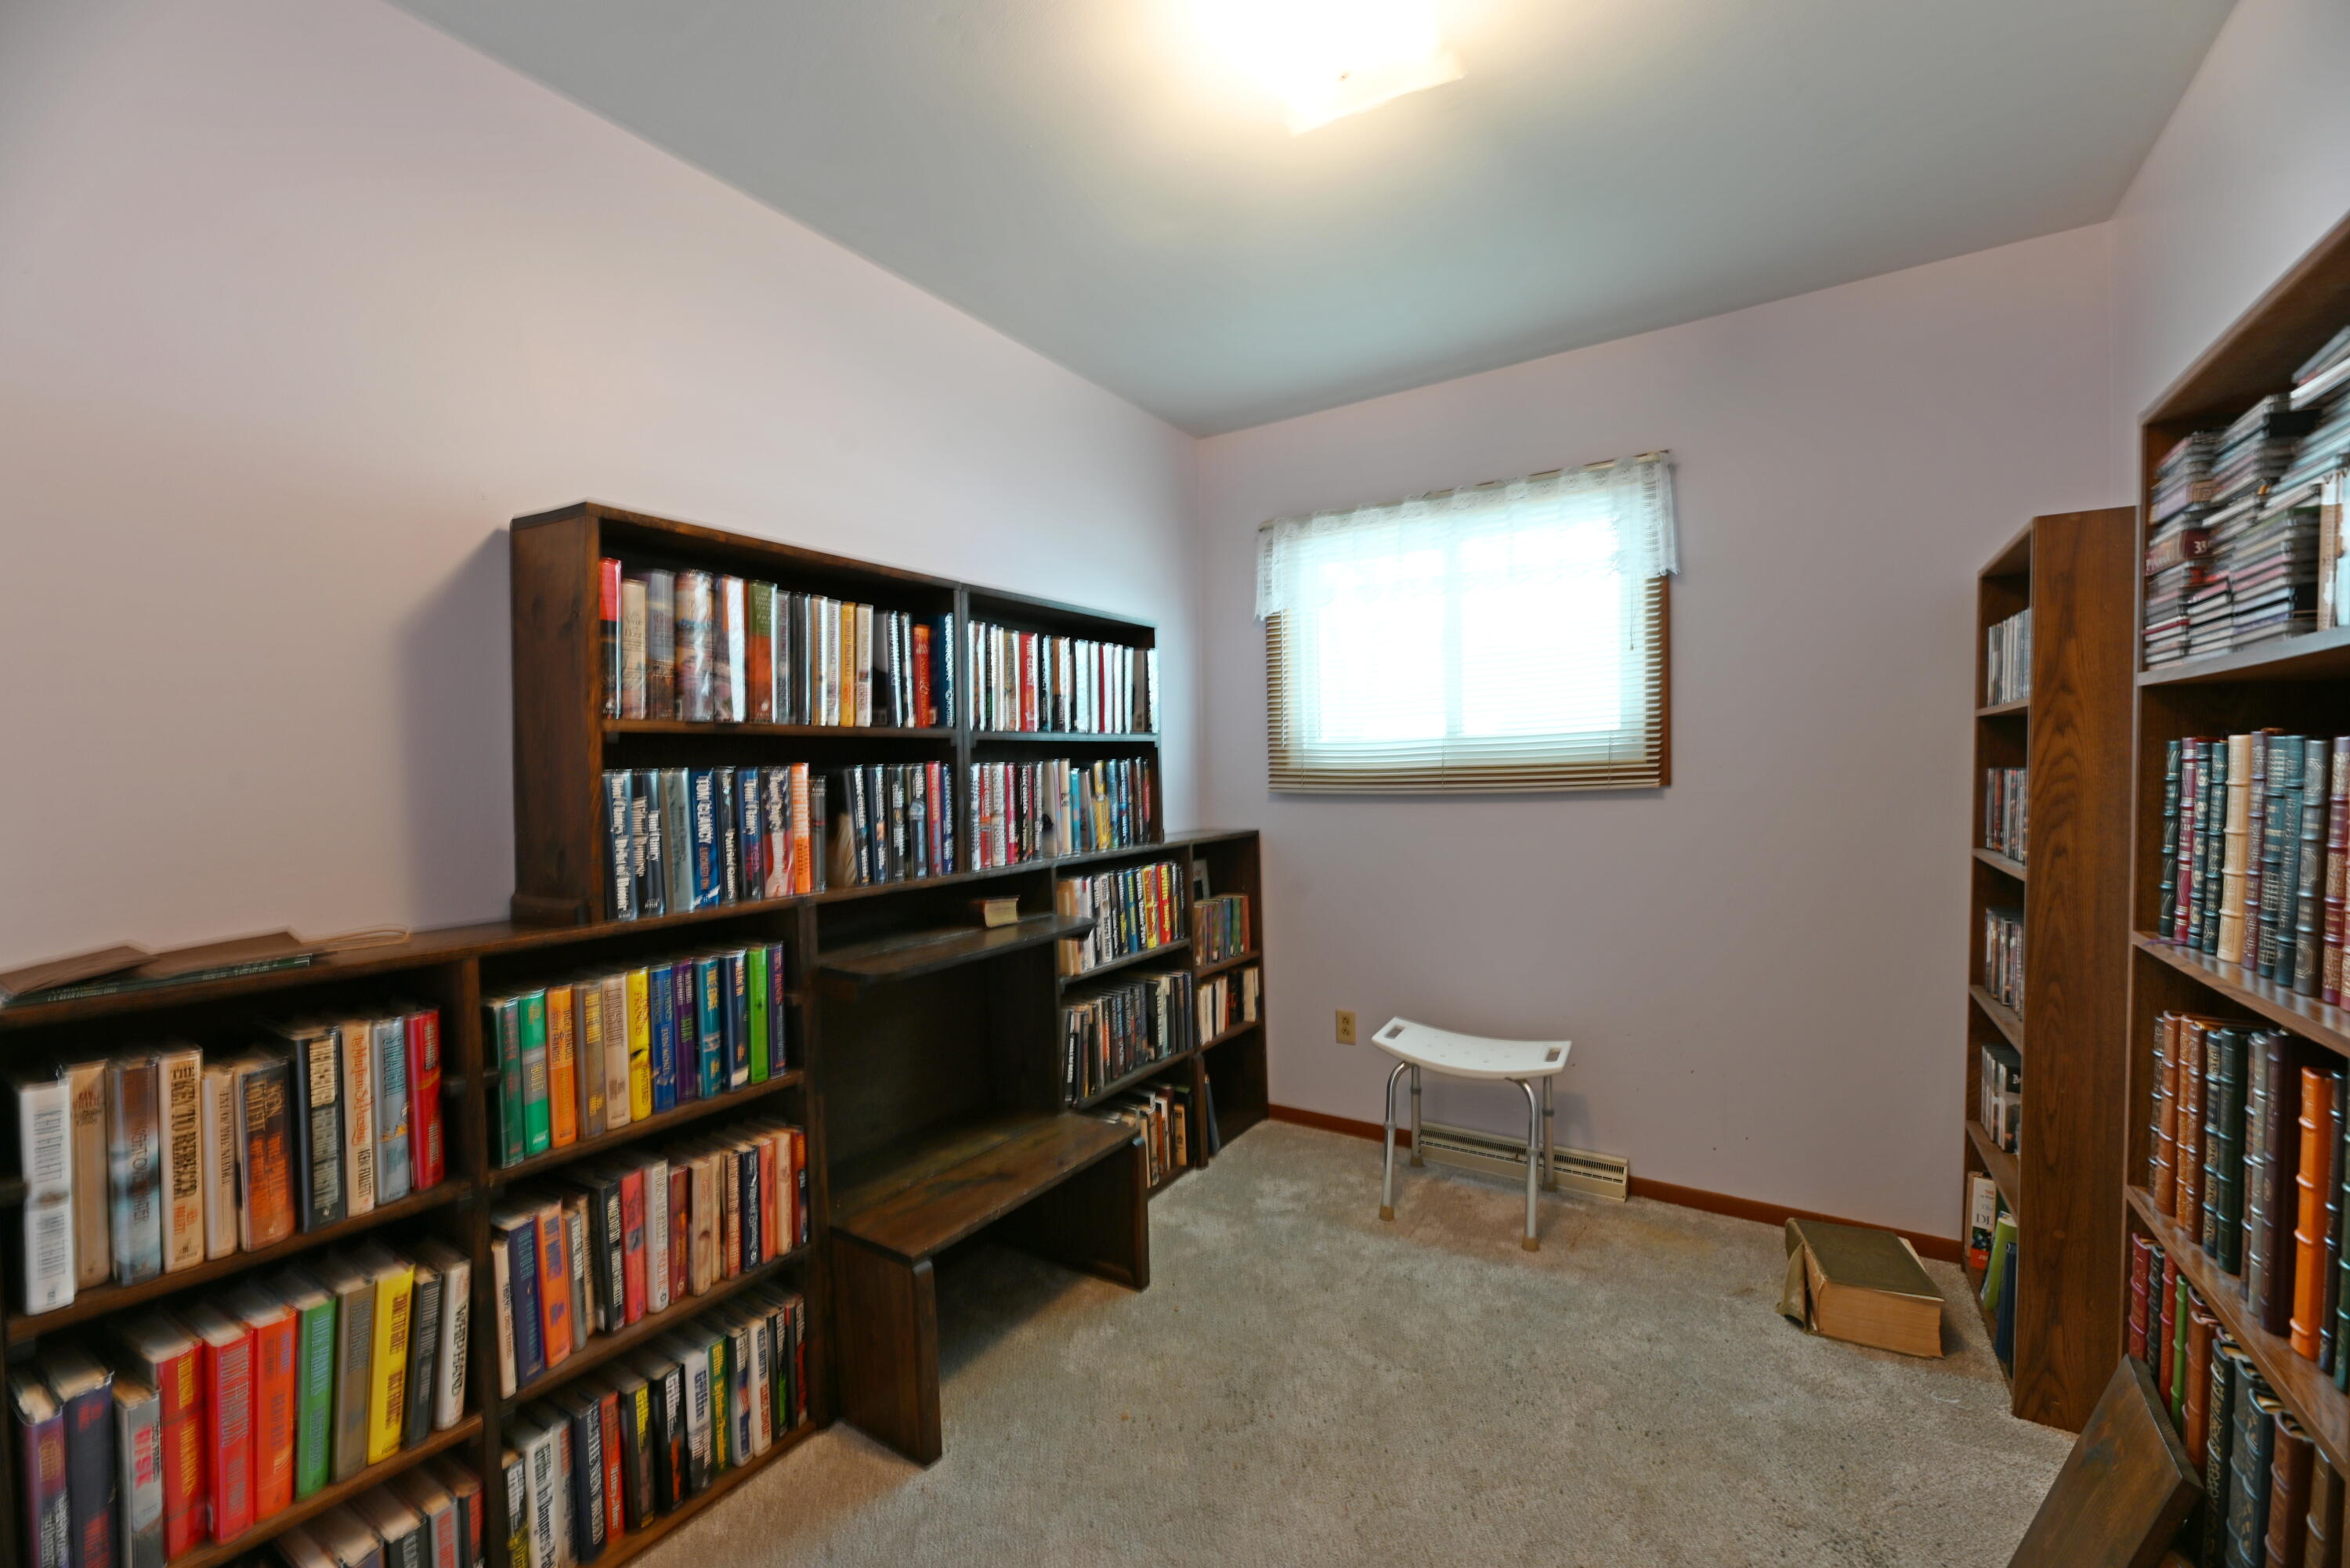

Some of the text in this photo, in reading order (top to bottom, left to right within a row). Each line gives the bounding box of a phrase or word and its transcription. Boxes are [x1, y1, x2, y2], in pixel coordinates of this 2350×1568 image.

[696, 775, 713, 844] TOM CLANCY
[171, 1079, 196, 1107] KEY
[172, 1108, 196, 1133] TO
[357, 1147, 371, 1166] KEN
[571, 1214, 583, 1281] TRIAL RUN
[452, 1303, 467, 1398] WHIP HAND
[134, 1425, 153, 1490] RISK
